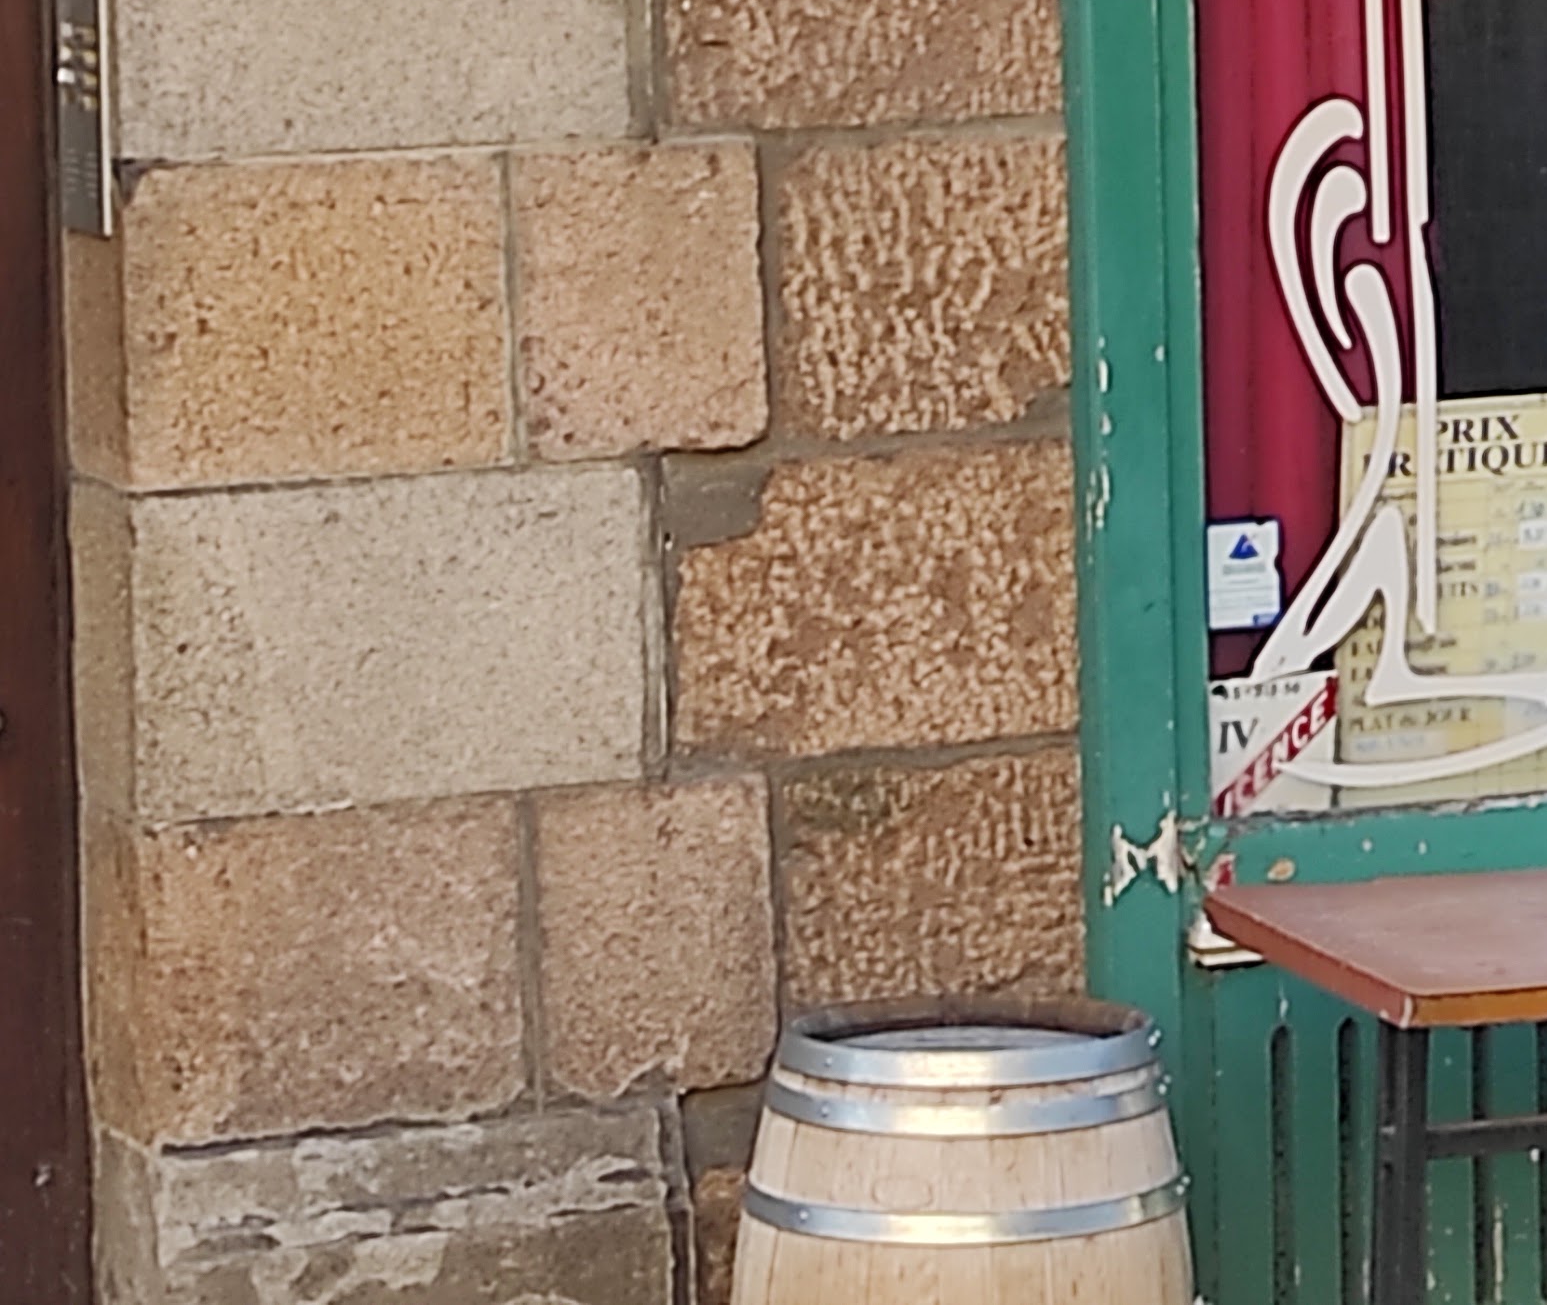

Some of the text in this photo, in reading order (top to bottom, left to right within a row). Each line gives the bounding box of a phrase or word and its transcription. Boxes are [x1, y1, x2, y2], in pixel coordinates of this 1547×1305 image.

[1437, 414, 1520, 444] PRIX
[1219, 716, 1259, 754] IV
[1222, 690, 1328, 817] ICENCE
